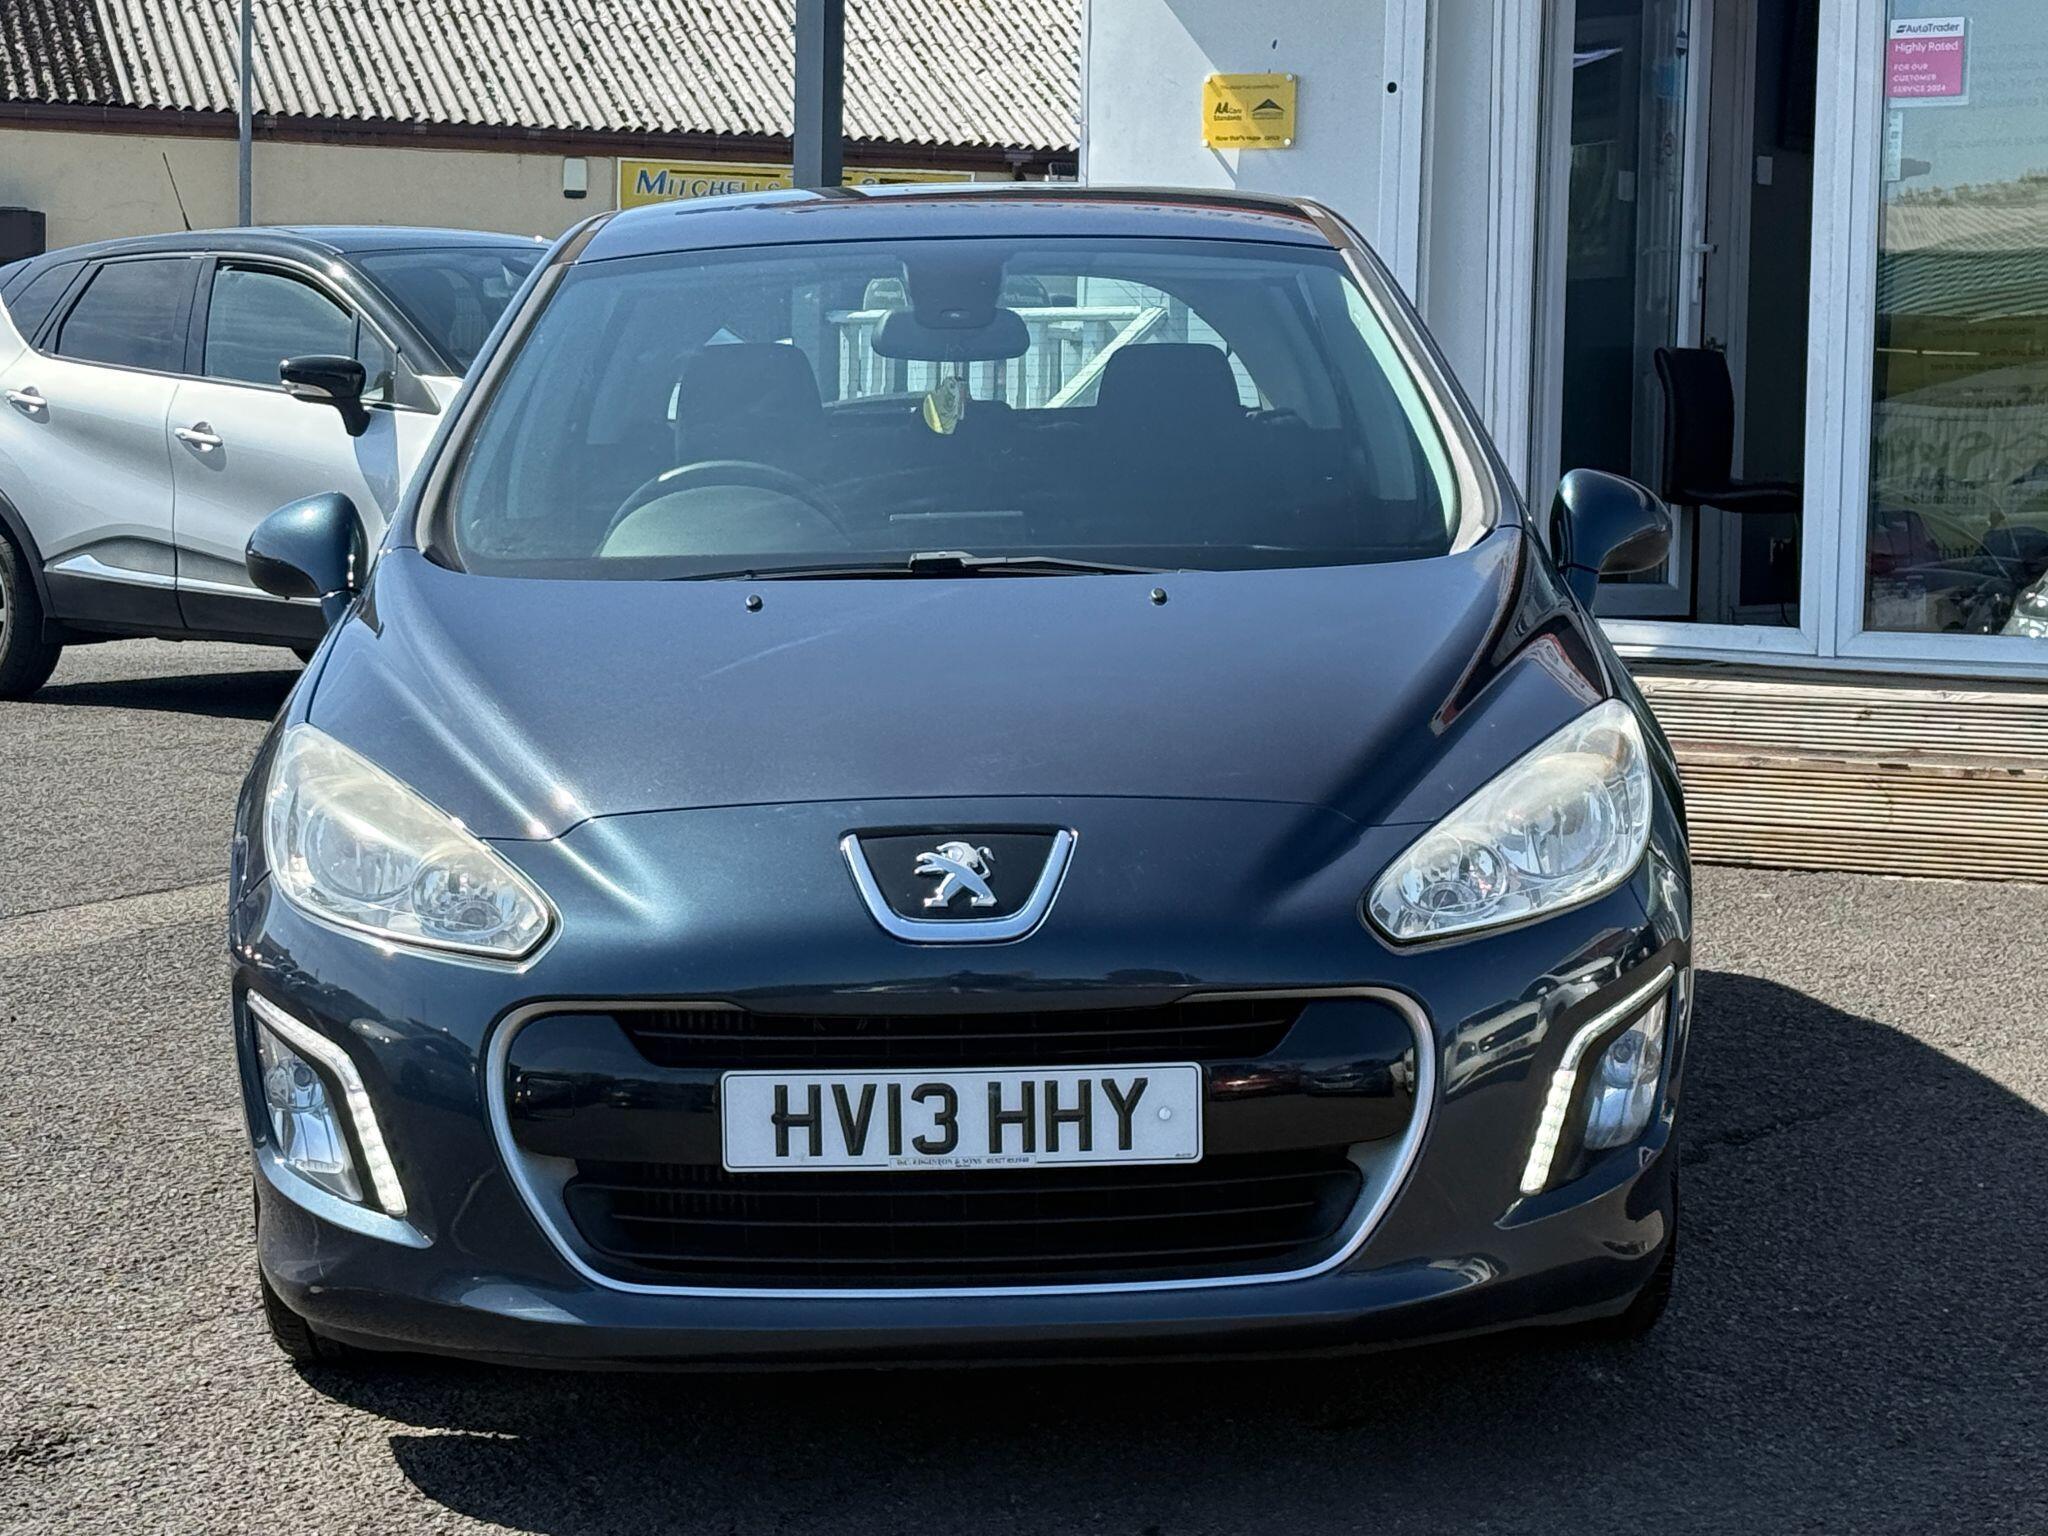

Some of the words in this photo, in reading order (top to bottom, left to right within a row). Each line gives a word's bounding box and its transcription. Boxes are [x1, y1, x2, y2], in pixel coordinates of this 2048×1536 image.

[1906, 23, 1960, 33] AutoTrader
[1895, 41, 1927, 54] Highly
[1928, 40, 1959, 51] Rated
[1893, 63, 1910, 71] FOR
[1911, 63, 1928, 71] OUR
[1892, 73, 1937, 82] CUSTOMER
[1892, 85, 1925, 93] SERVICE
[771, 1082, 959, 1157] HV13
[987, 1078, 1149, 1154] HHY
